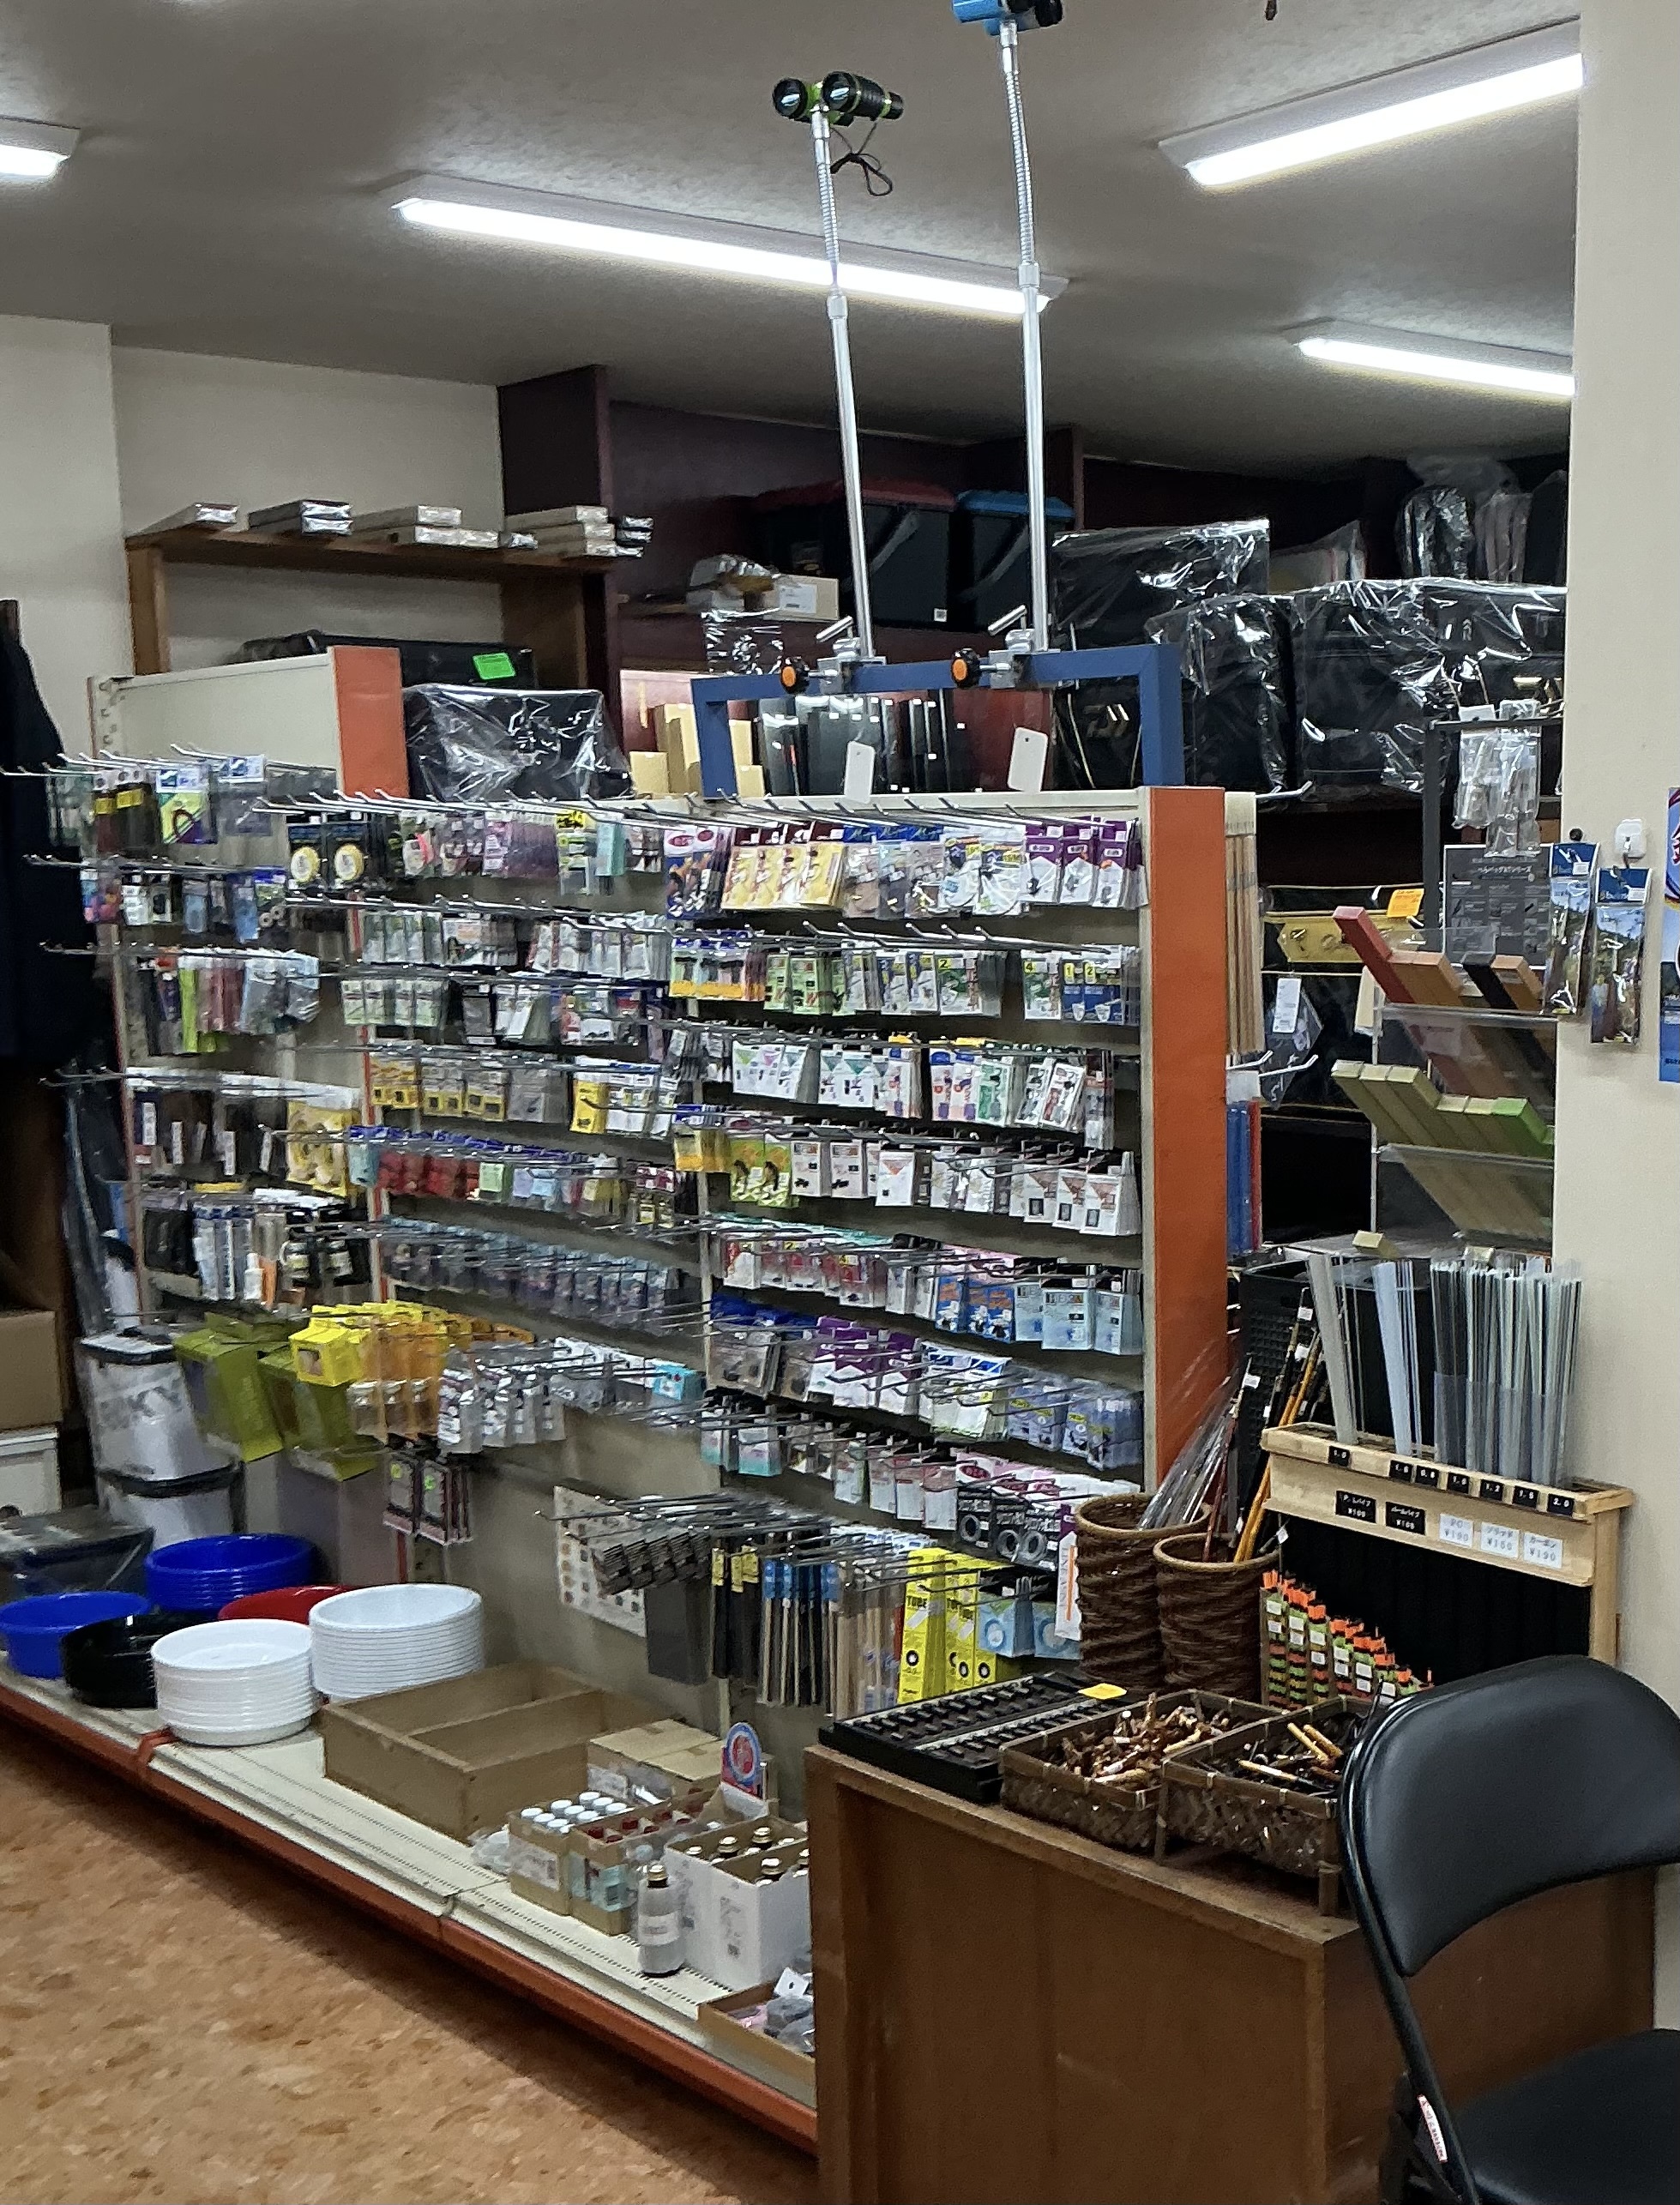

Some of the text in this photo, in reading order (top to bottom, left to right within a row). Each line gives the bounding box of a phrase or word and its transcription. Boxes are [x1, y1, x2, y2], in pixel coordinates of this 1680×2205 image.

[939, 959, 948, 969] 2
[1025, 962, 1033, 973] 4
[1485, 1483, 1500, 1492] 1.2
[1553, 1497, 1570, 1508] 2.0
